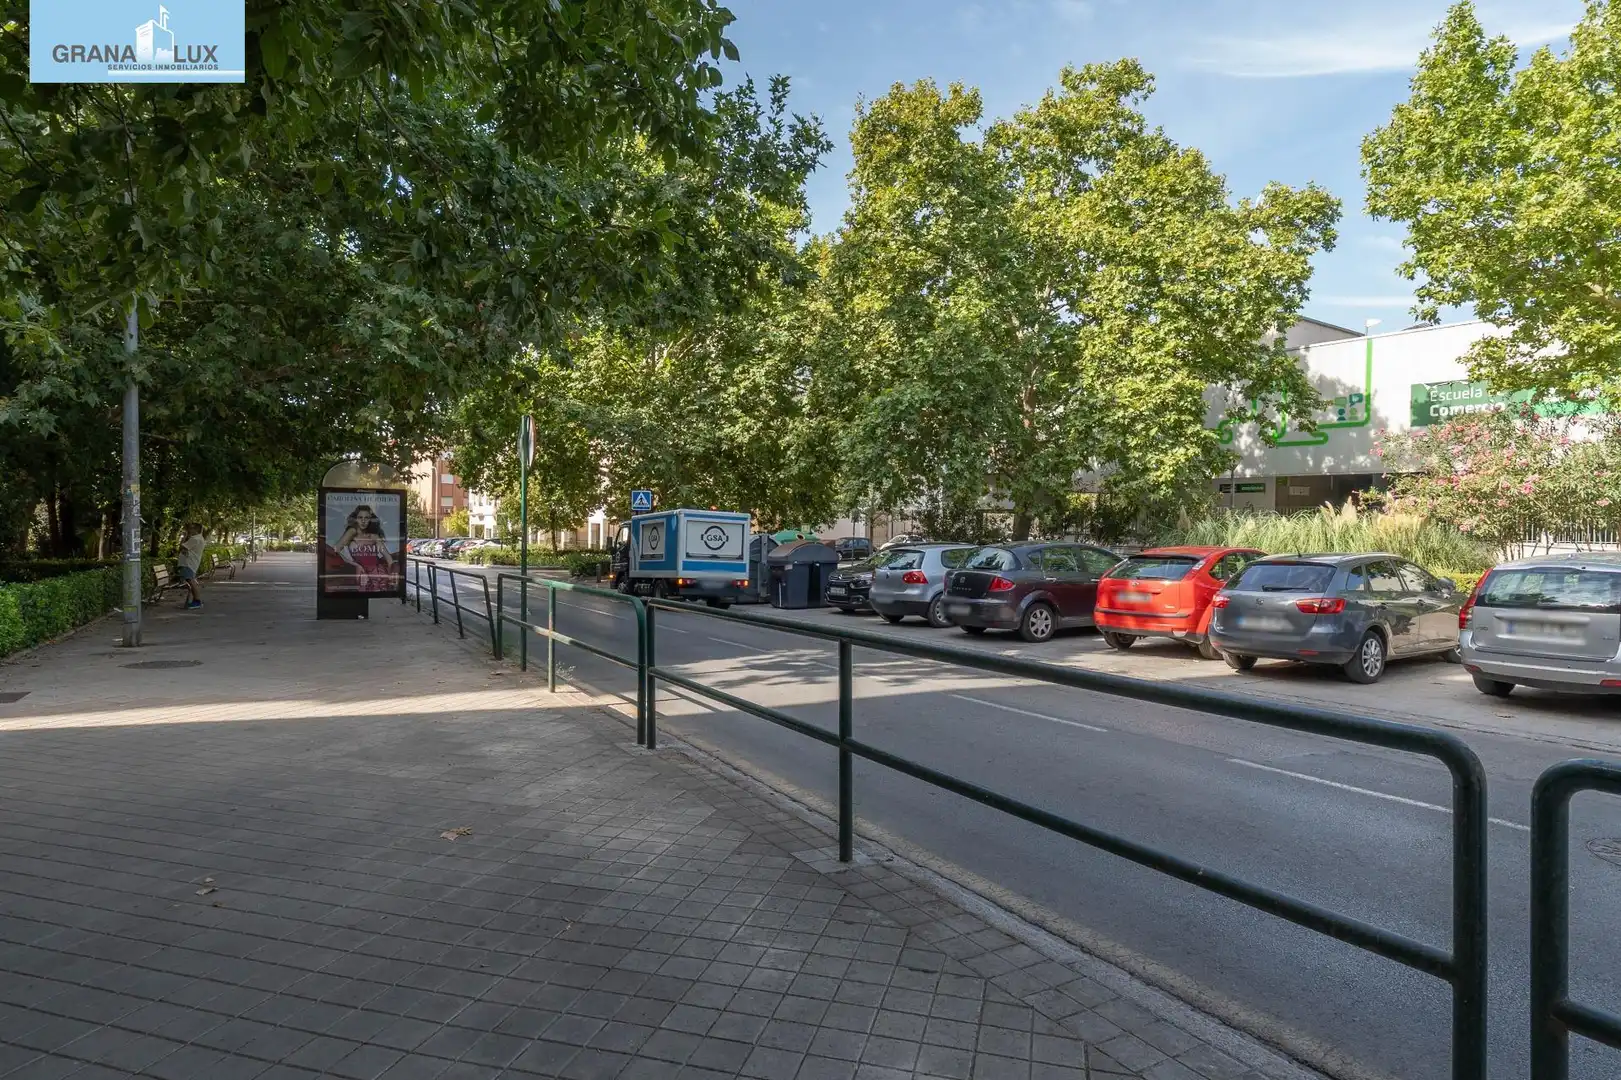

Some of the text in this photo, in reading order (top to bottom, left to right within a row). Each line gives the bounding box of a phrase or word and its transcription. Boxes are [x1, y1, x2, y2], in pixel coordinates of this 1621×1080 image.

[1430, 387, 1483, 402] Escuela
[1429, 402, 1506, 417] Comerco
[706, 534, 723, 542] GSA
